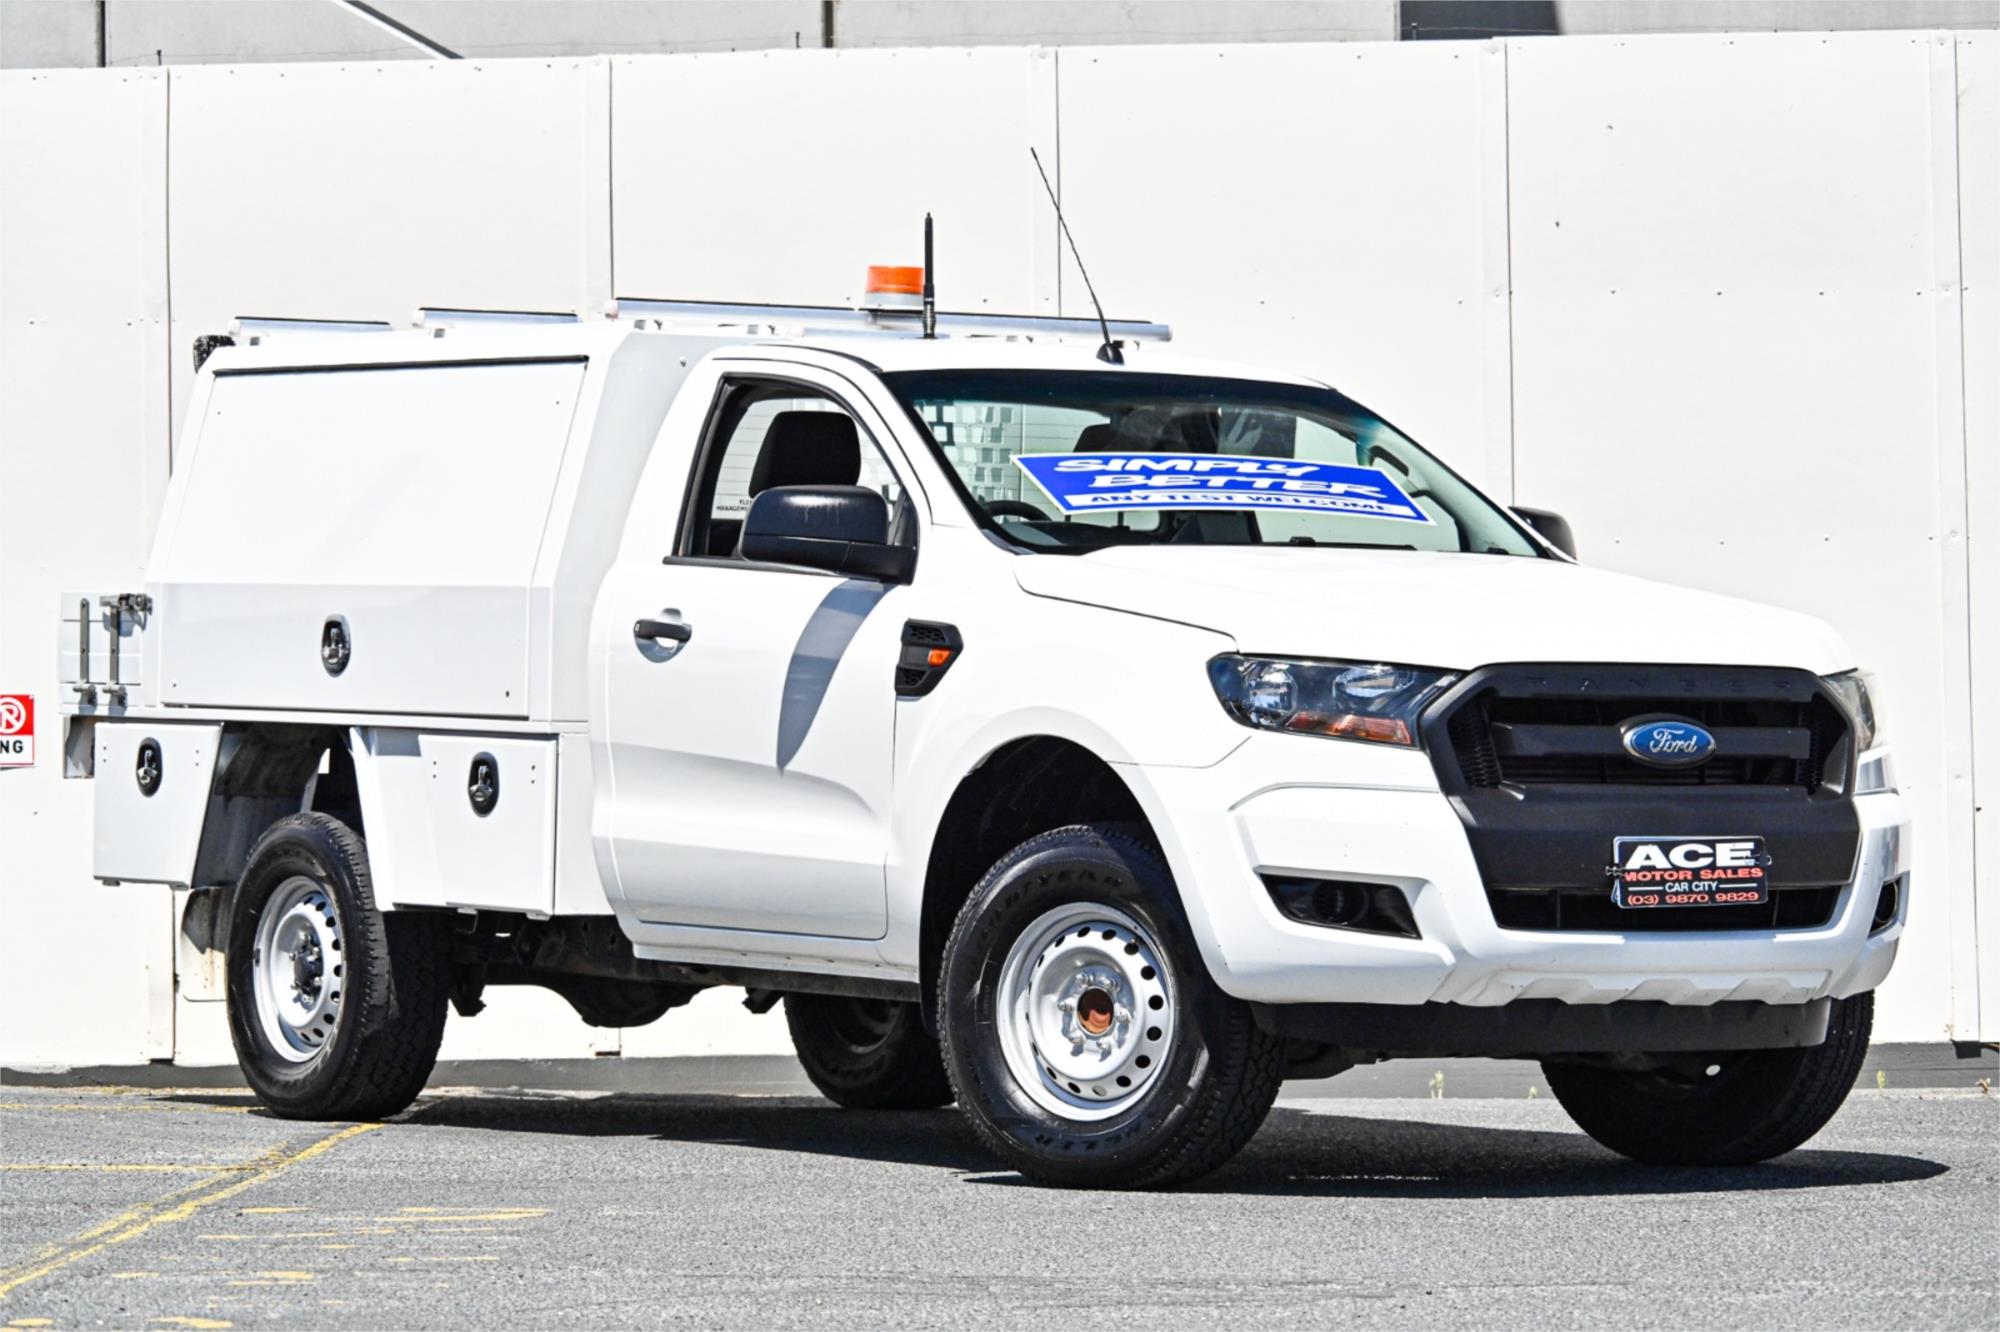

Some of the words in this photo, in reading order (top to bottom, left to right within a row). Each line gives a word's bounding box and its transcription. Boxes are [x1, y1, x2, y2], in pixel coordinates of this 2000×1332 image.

[1053, 458, 1321, 477] SIMPLY
[1088, 474, 1388, 498] BETTER
[1091, 494, 1152, 502] ANY
[1163, 493, 1236, 501] TEST
[1246, 494, 1389, 511] WELCOME
[1649, 727, 1698, 753] Ford
[1625, 842, 1755, 869] ACE
[1624, 869, 1693, 882] MOTOR
[1700, 867, 1764, 880] SALES
[1665, 881, 1690, 893] CAR
[1692, 881, 1718, 892] CITY
[1627, 894, 1660, 906] (03)
[1665, 893, 1709, 904] 9870
[1715, 891, 1760, 902] 9829
